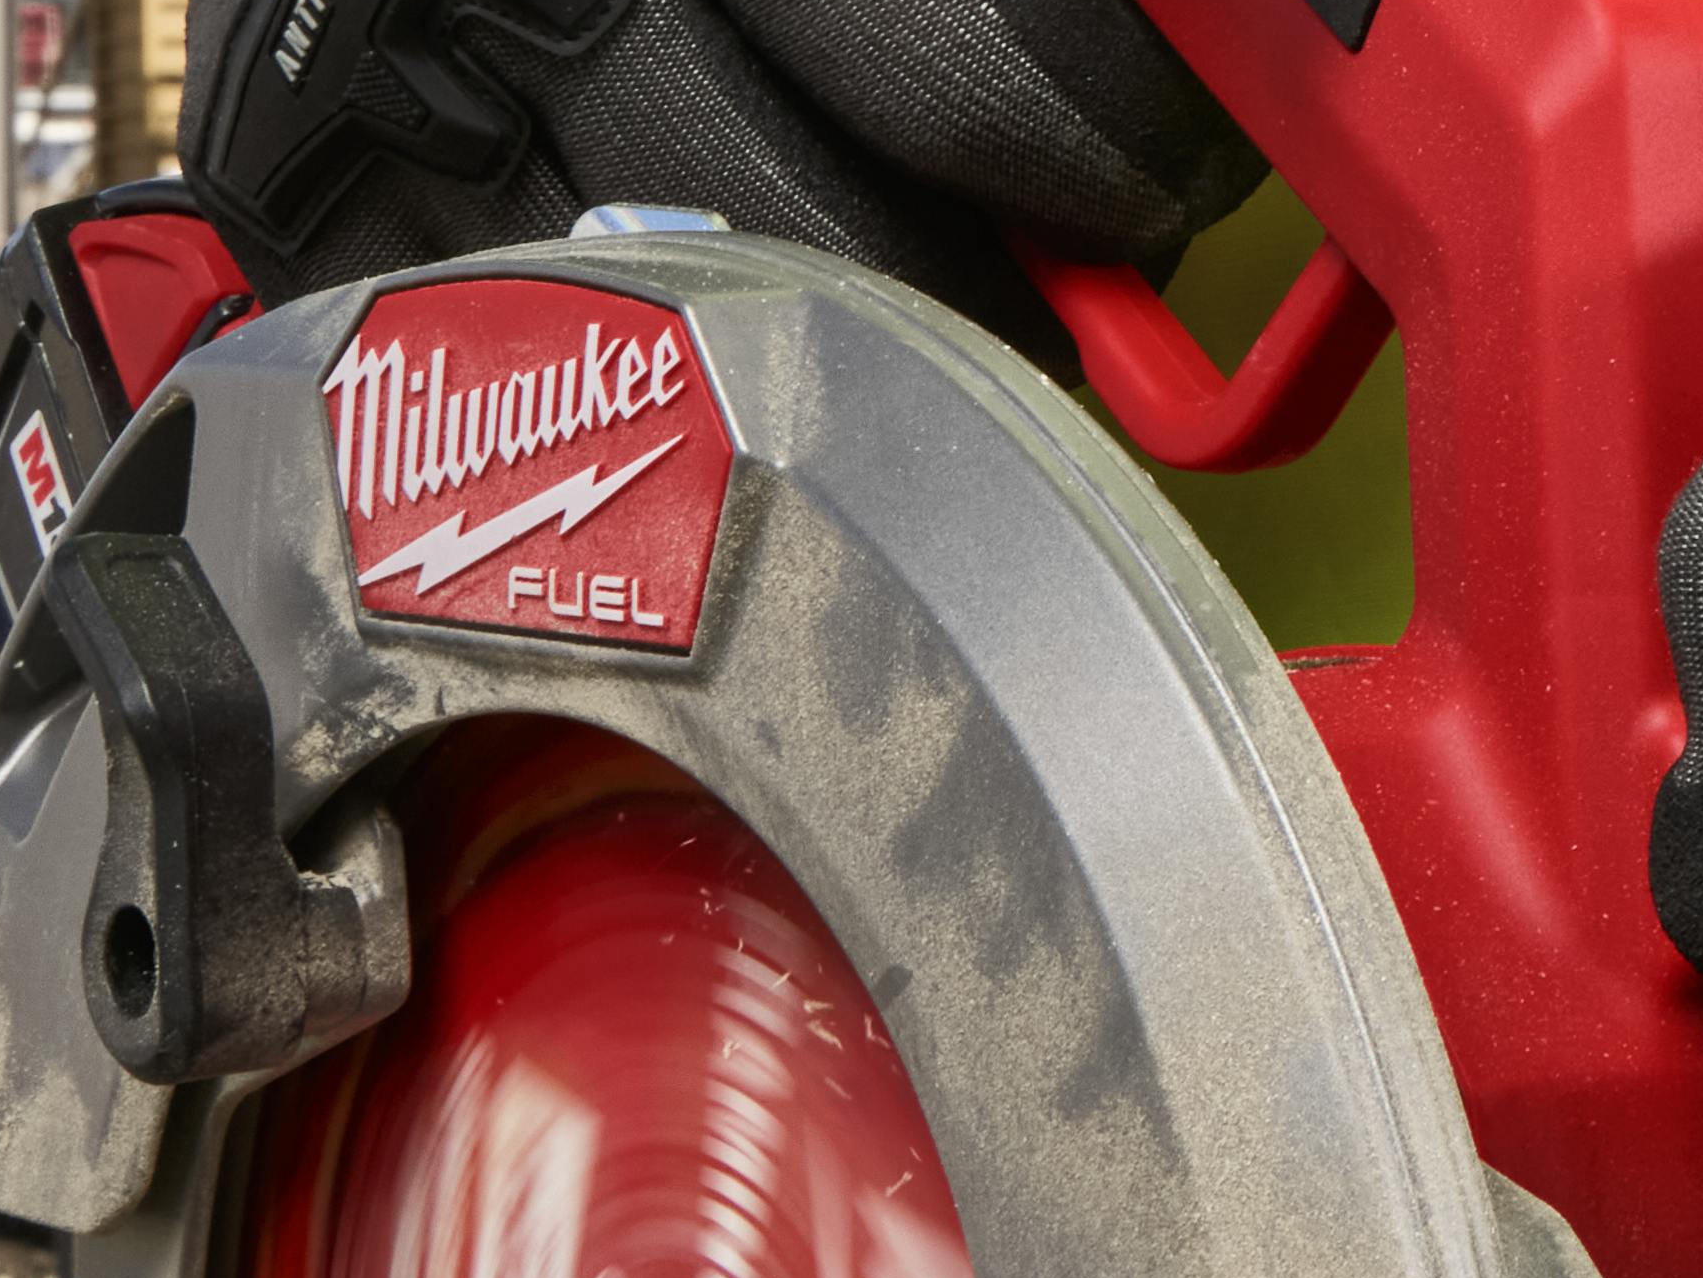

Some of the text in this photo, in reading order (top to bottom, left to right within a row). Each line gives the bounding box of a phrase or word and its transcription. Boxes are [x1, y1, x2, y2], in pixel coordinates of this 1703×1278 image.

[322, 322, 685, 521] Milwaukee
[18, 426, 68, 545] M1
[507, 565, 664, 627] FUEL
